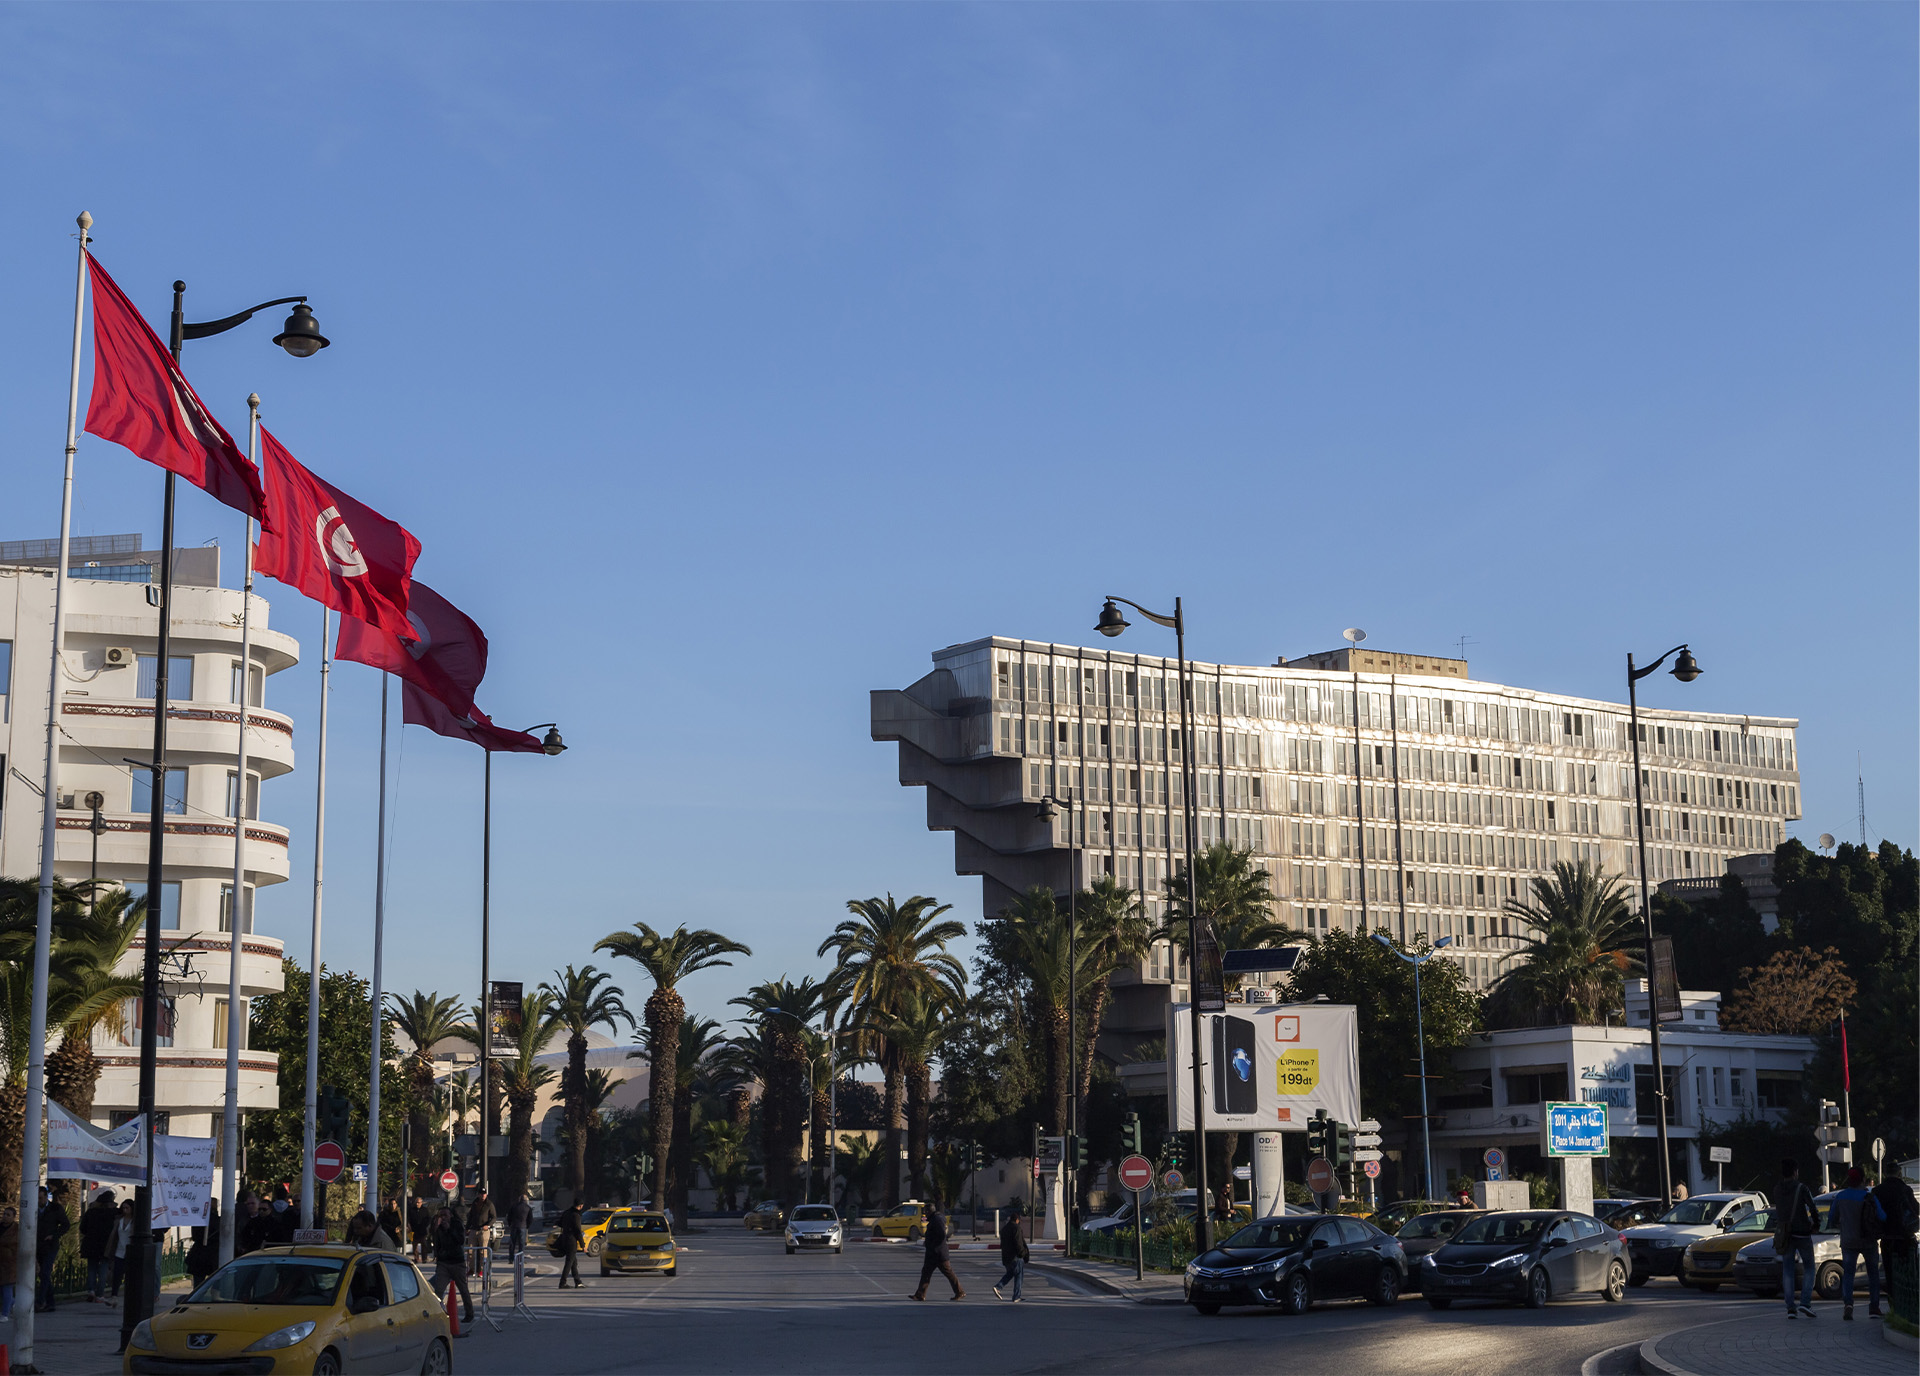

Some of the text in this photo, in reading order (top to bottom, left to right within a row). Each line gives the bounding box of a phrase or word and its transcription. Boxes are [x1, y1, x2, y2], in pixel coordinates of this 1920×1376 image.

[1554, 1114, 1567, 1126] 2011
[1581, 1114, 1588, 1126] 14
[1555, 1135, 1602, 1147] Place 14 Janvier 2011
